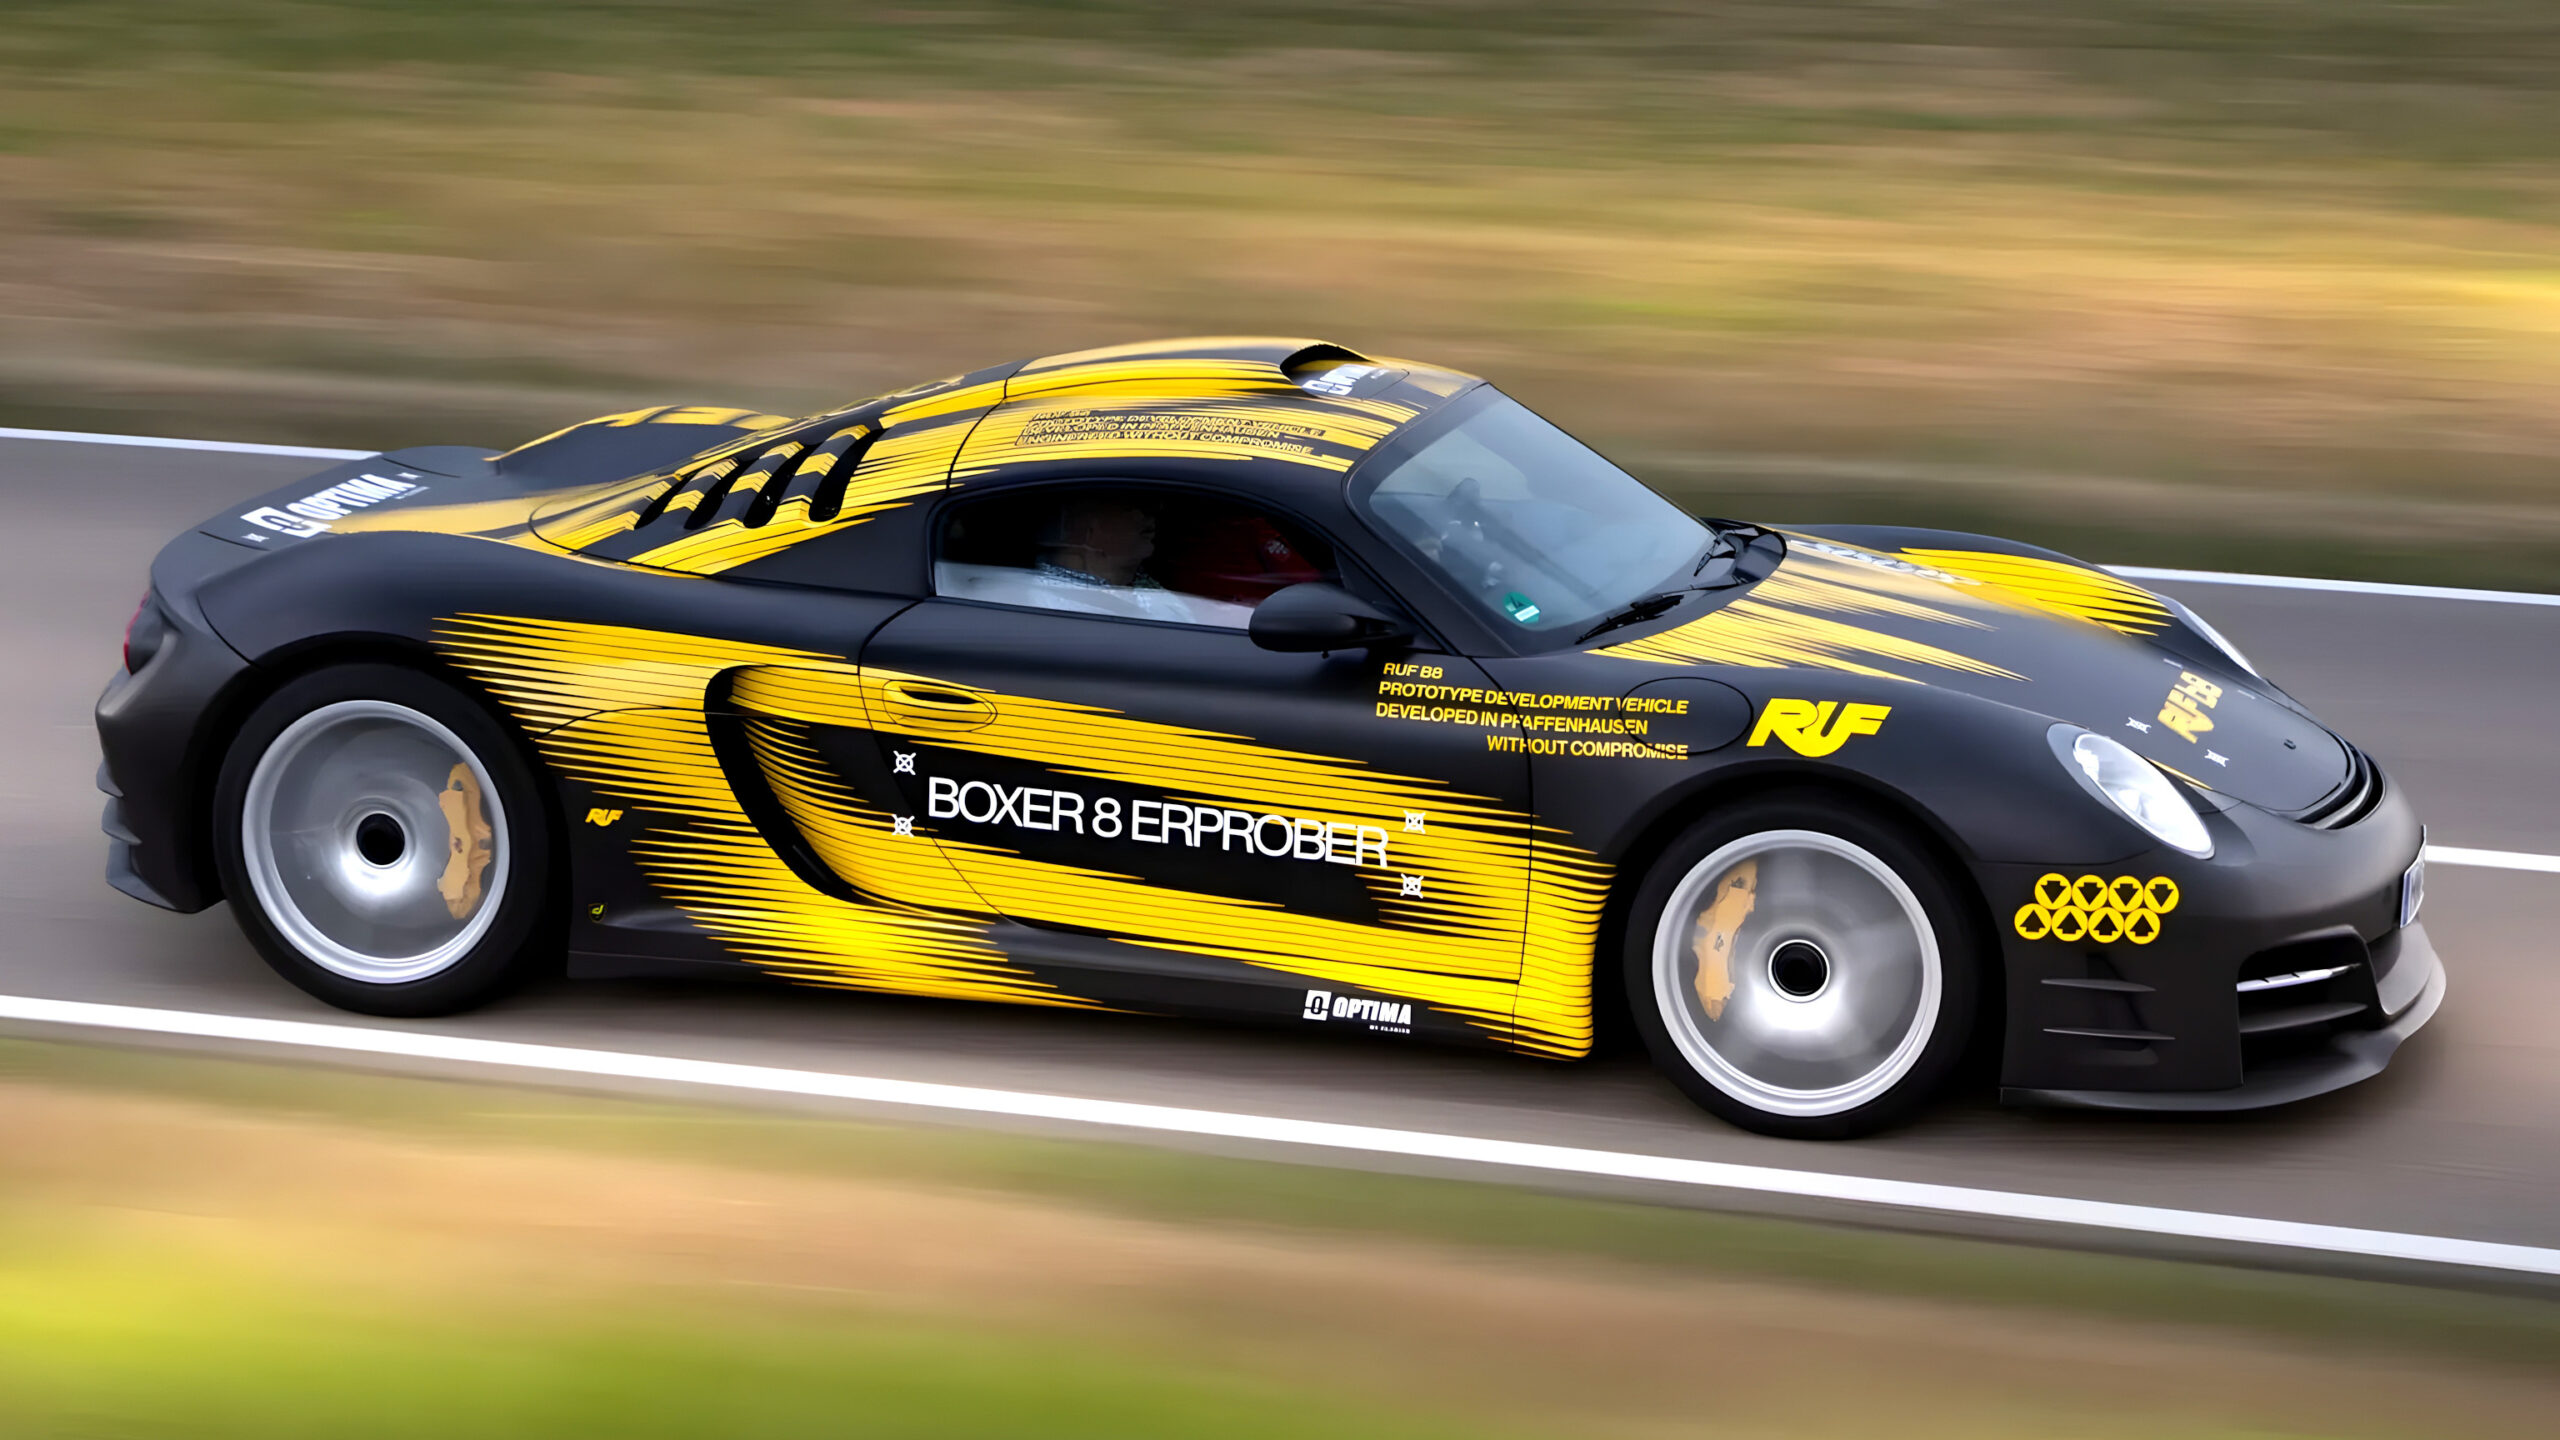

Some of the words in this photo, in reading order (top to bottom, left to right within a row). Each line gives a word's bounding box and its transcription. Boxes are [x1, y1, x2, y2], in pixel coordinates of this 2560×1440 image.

[286, 474, 416, 520] OPTIMA
[1384, 662, 1418, 677] RUF
[1420, 665, 1443, 679] B8
[1379, 681, 1483, 704] PROTOTYPE
[1485, 690, 1614, 711] DEVELOPMENT
[1615, 697, 1688, 715] VEHICLE
[1376, 702, 1478, 725] DEVELOPED
[1480, 711, 1498, 728] IN
[1500, 713, 1648, 735] PFAFFENHAUSEN
[1746, 697, 1892, 758] RUF
[1487, 735, 1567, 756] WITHOUT
[1570, 740, 1688, 760] COMPROMISE
[585, 808, 624, 827] RUF
[928, 776, 1084, 835] BOXER
[1092, 797, 1122, 838] 8
[1131, 800, 1389, 868] ERPROBER
[1332, 996, 1412, 1025] OPTIMA
